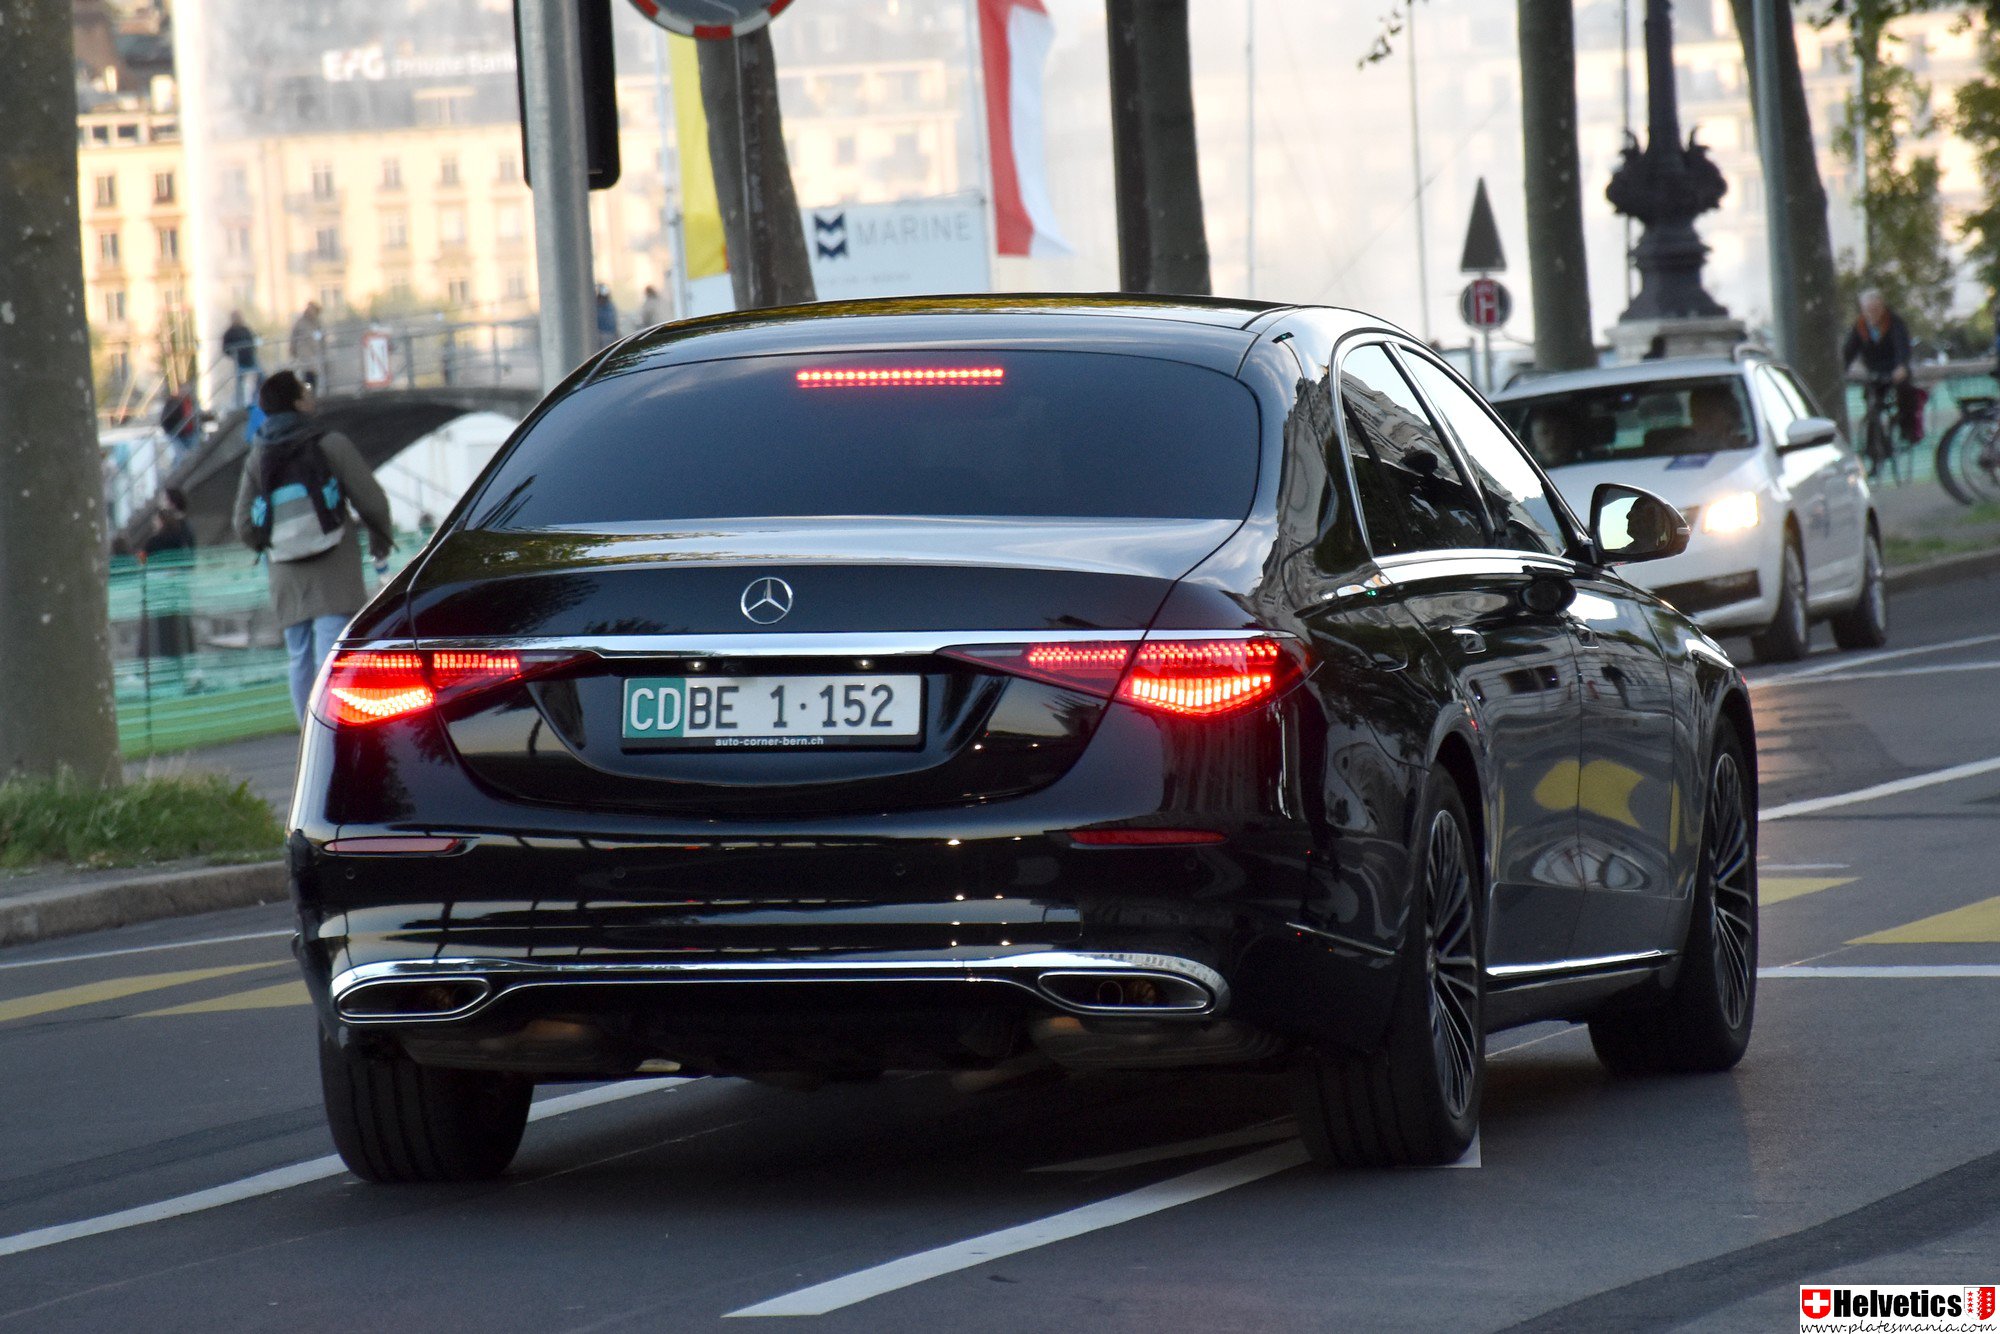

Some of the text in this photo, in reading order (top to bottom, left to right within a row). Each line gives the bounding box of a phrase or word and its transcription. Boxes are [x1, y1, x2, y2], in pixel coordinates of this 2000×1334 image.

[856, 212, 972, 245] MARINE
[630, 687, 682, 731] CD
[689, 686, 740, 730] BE
[715, 736, 824, 747] auto-corner-bern.ch
